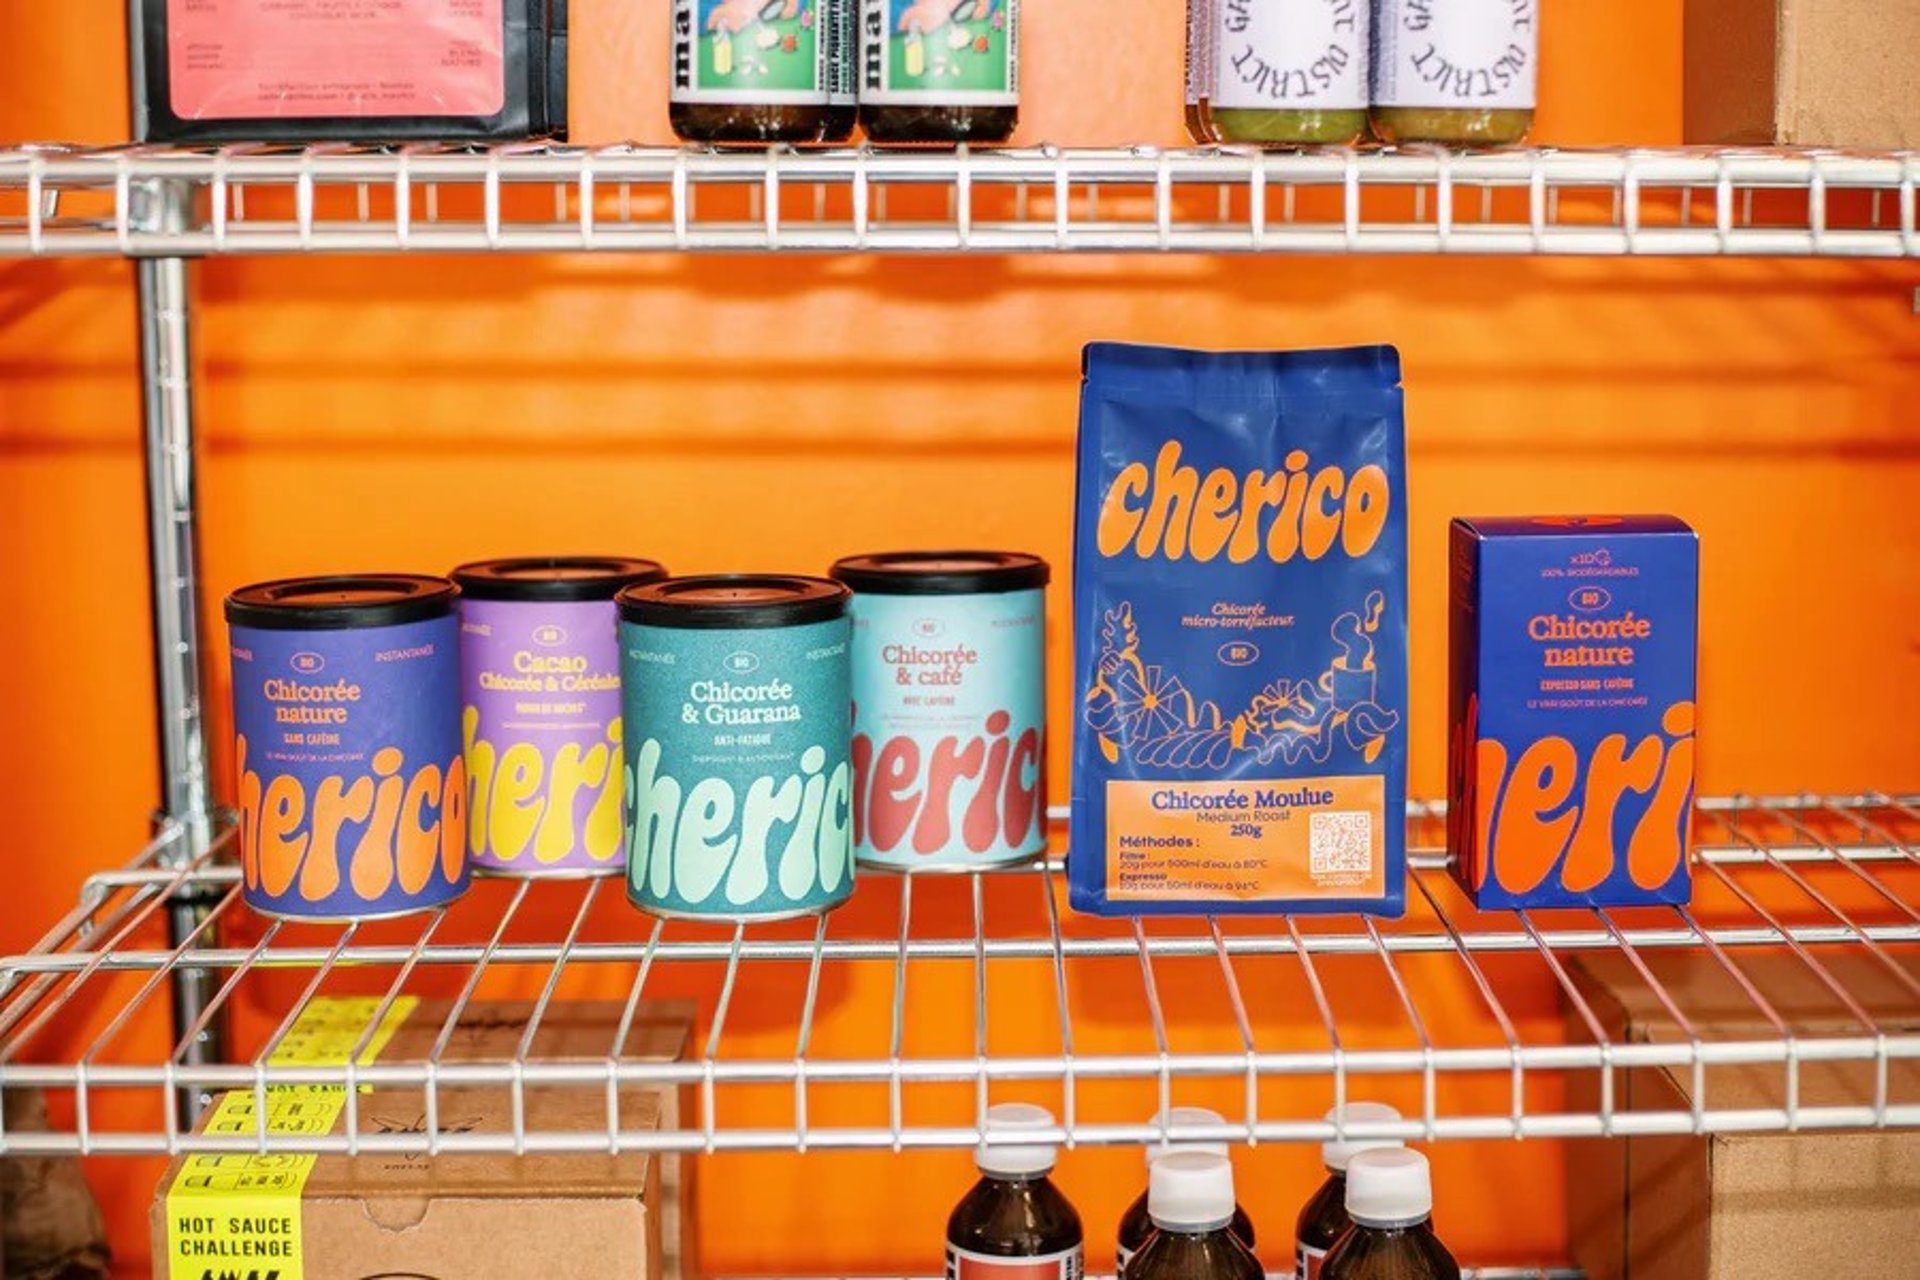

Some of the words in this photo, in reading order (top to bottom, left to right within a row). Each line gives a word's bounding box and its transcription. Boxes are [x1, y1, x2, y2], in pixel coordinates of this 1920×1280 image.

[1231, 44, 1348, 98] DISTRICT
[1411, 43, 1526, 97] DISTRICT
[1097, 440, 1390, 564] cherico
[1212, 602, 1265, 616] Chicorée
[1528, 611, 1651, 640] Chicorée
[514, 650, 588, 673] Cacao
[882, 644, 977, 665] Chicorée
[1544, 645, 1635, 667] nature
[896, 667, 911, 685] &
[918, 664, 962, 685] café
[264, 677, 361, 702] Chicorée
[690, 678, 793, 703] Chicorée
[276, 705, 348, 723] nature
[682, 703, 699, 724] &
[705, 703, 802, 724] Guarana
[1151, 788, 1249, 810] Chicorée
[1254, 786, 1334, 809] Moulue
[1196, 811, 1251, 823] Medium
[1254, 809, 1291, 821] Roast
[1120, 835, 1193, 848] Méthodes
[1230, 824, 1263, 839] 250g
[179, 1217, 215, 1234] HOT
[229, 1217, 292, 1235] SAUCE
[180, 1239, 293, 1257] CHALLENGE
